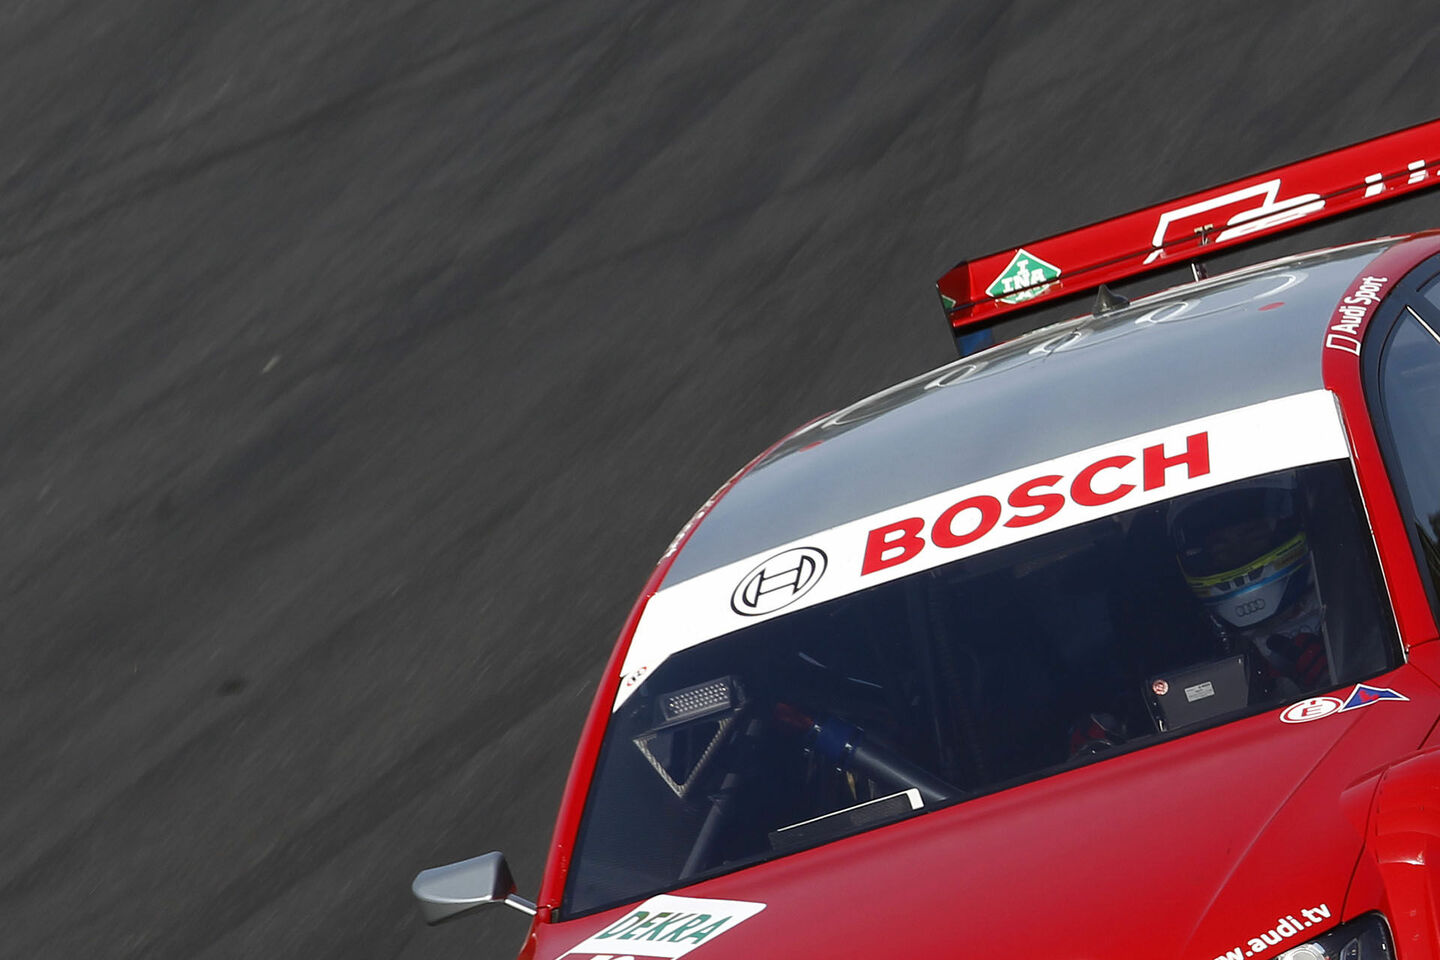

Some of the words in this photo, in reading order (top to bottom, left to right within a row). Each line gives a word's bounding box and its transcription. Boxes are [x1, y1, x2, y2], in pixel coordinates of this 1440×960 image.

[1344, 275, 1388, 306] Sport
[1331, 303, 1368, 335] Audi
[860, 431, 1211, 576] BOSCH
[595, 911, 732, 945] DEKRA
